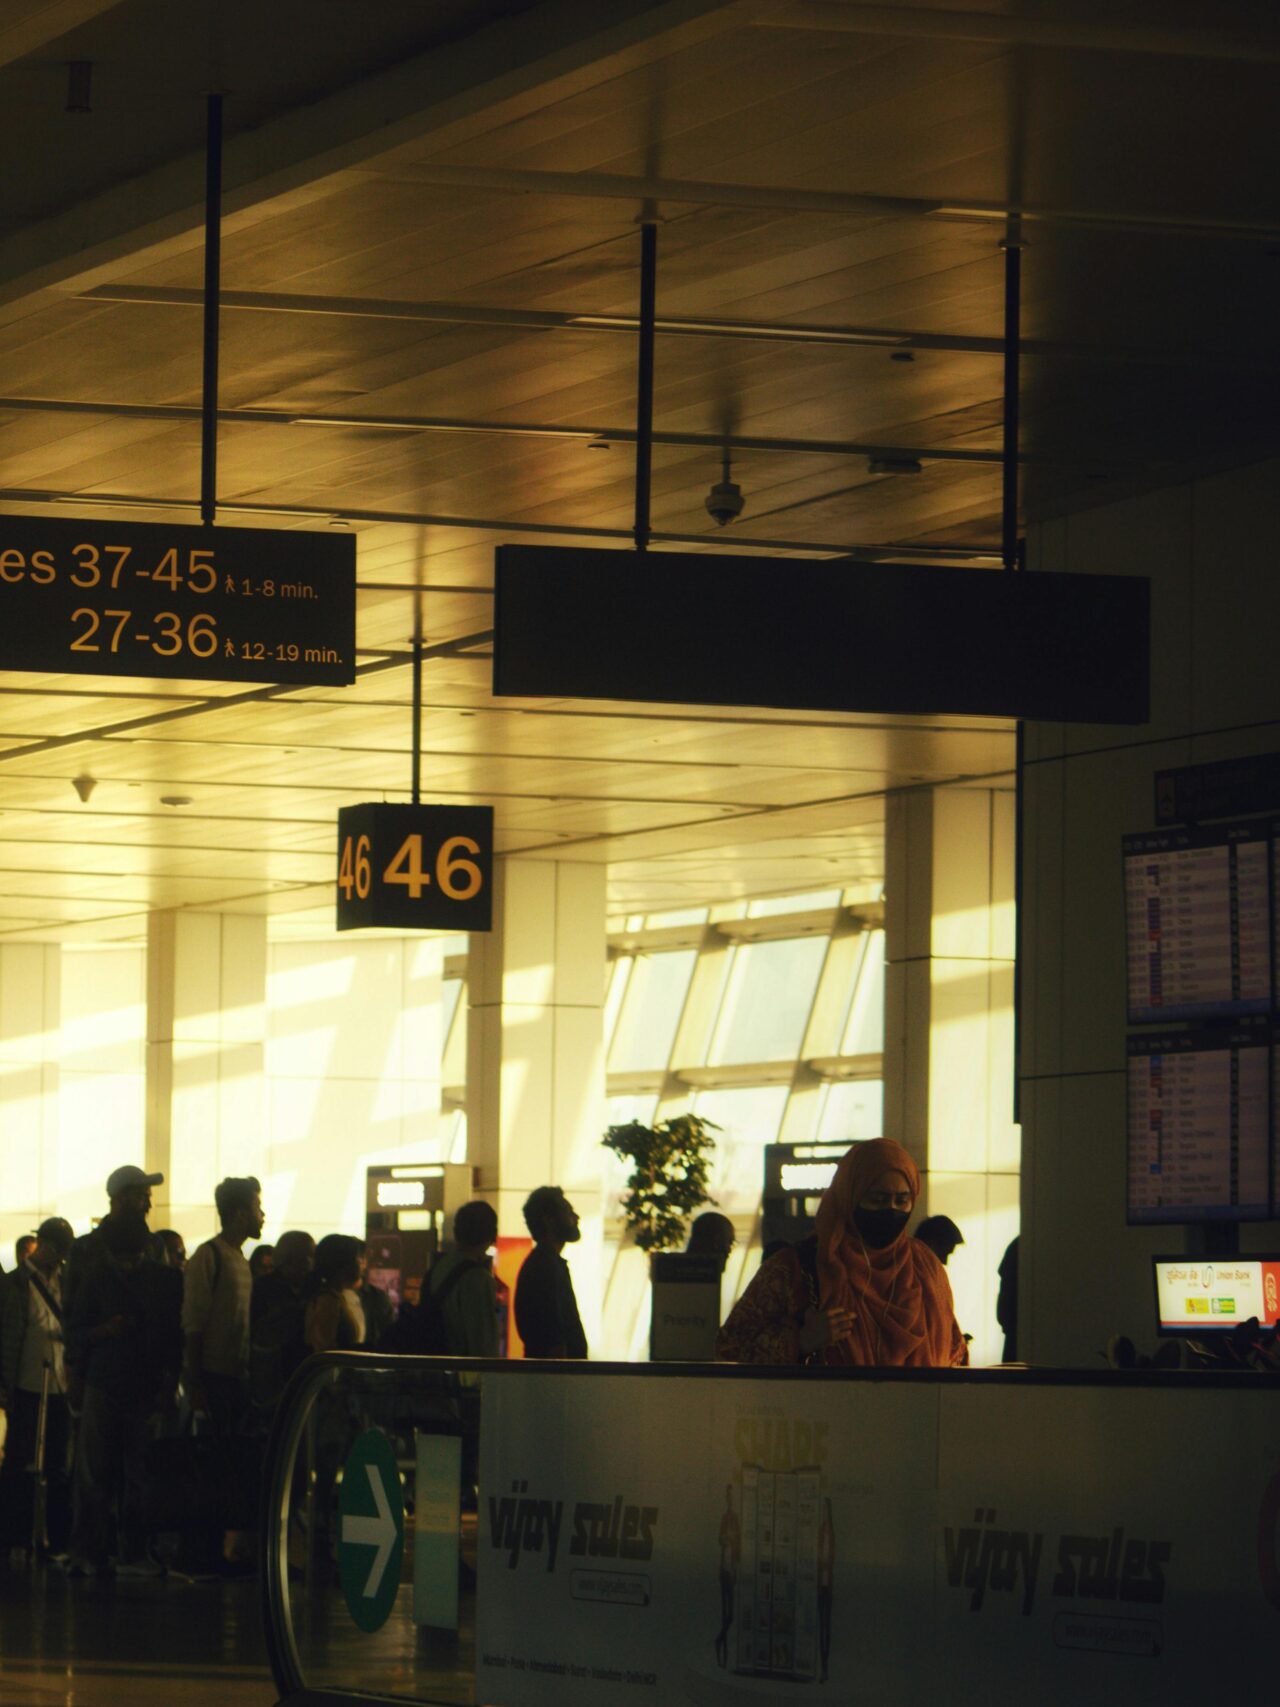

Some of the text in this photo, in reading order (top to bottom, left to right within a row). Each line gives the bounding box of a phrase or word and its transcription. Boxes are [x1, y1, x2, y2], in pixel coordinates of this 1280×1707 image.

[69, 543, 218, 593] 37-45
[243, 578, 276, 597] 1-8
[281, 581, 319, 600] min.
[69, 607, 344, 664] 27-36 12-19 min.
[338, 834, 372, 901] 46
[382, 834, 483, 901] 46
[570, 1495, 659, 1561] sales
[1051, 1526, 1173, 1604] sales
